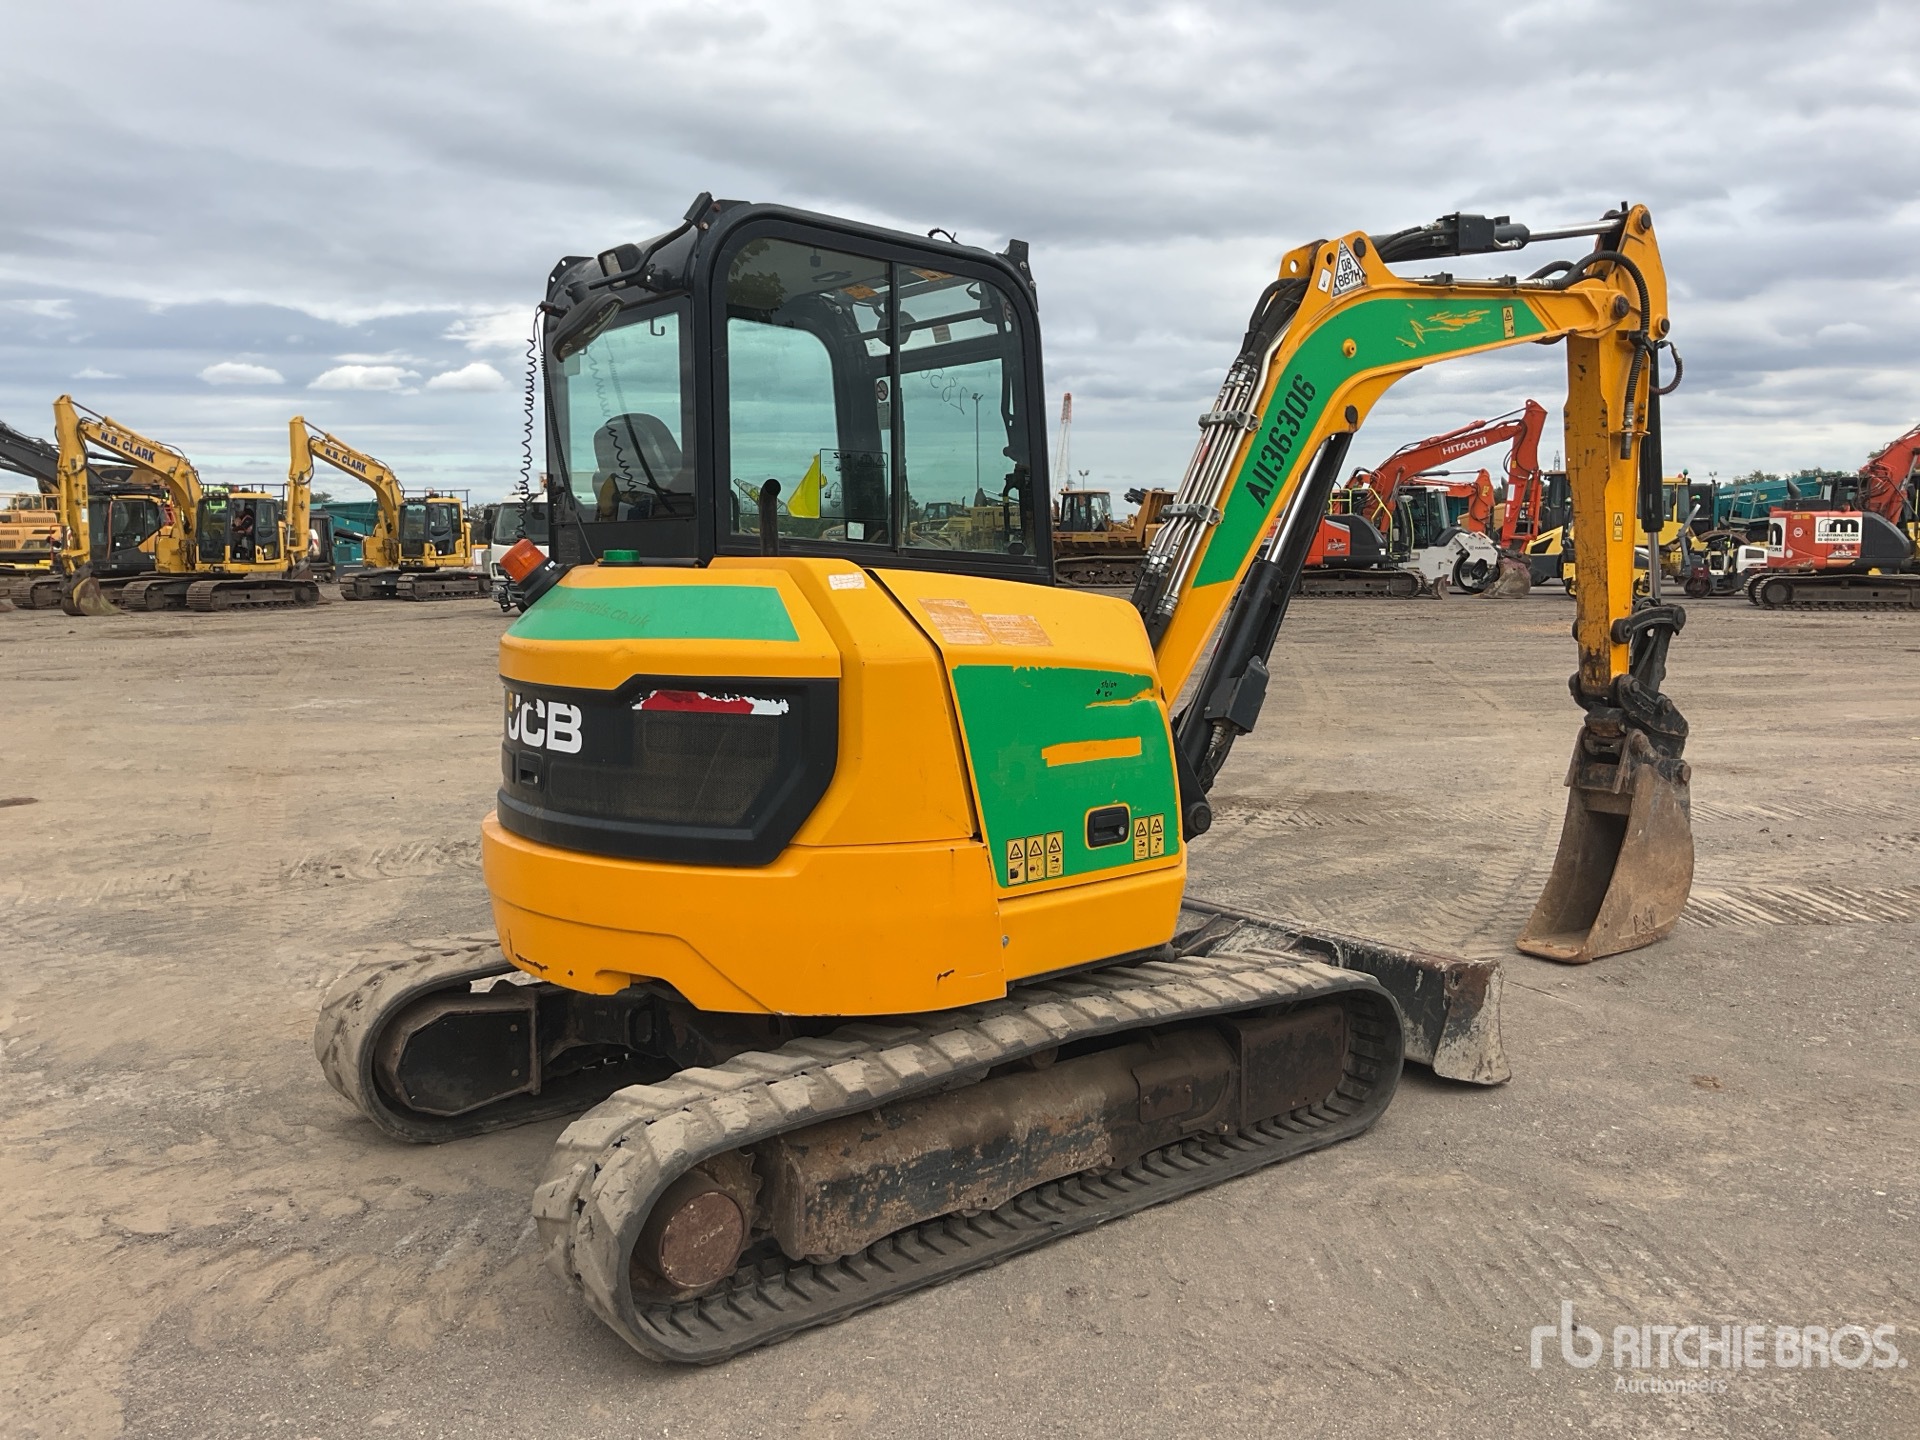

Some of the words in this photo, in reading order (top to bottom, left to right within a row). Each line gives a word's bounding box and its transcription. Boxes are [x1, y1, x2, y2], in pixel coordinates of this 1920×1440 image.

[101, 431, 120, 447] N.B.
[122, 440, 155, 463] CLARK
[1442, 436, 1488, 455] HITACHI
[325, 448, 340, 461] N.B.
[341, 455, 367, 474] CLARK
[508, 693, 582, 754] JCB
